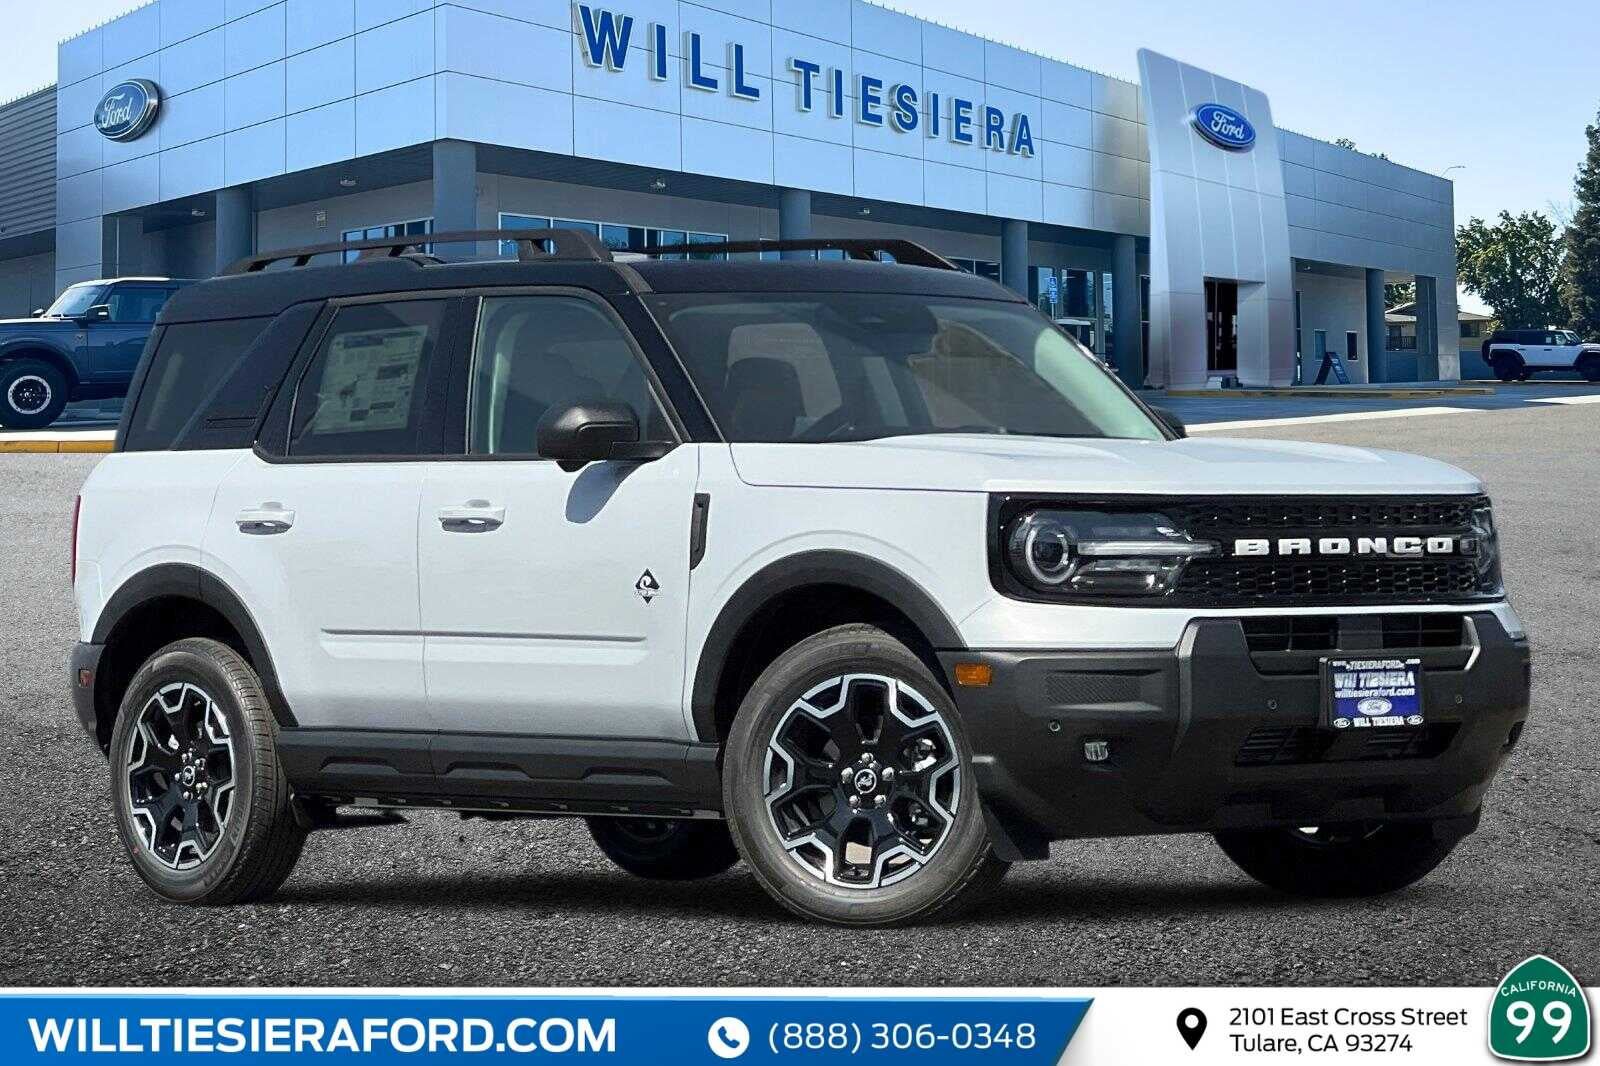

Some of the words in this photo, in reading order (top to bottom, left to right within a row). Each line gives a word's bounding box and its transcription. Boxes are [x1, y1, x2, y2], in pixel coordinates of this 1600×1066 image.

[574, 3, 760, 101] WILL
[788, 57, 1035, 158] TIESIERA
[102, 93, 133, 129] Ford
[1211, 111, 1245, 140] Ford
[1234, 537, 1453, 556] BRONCO
[1334, 672, 1357, 688] WILL
[1353, 717, 1371, 727] WILL
